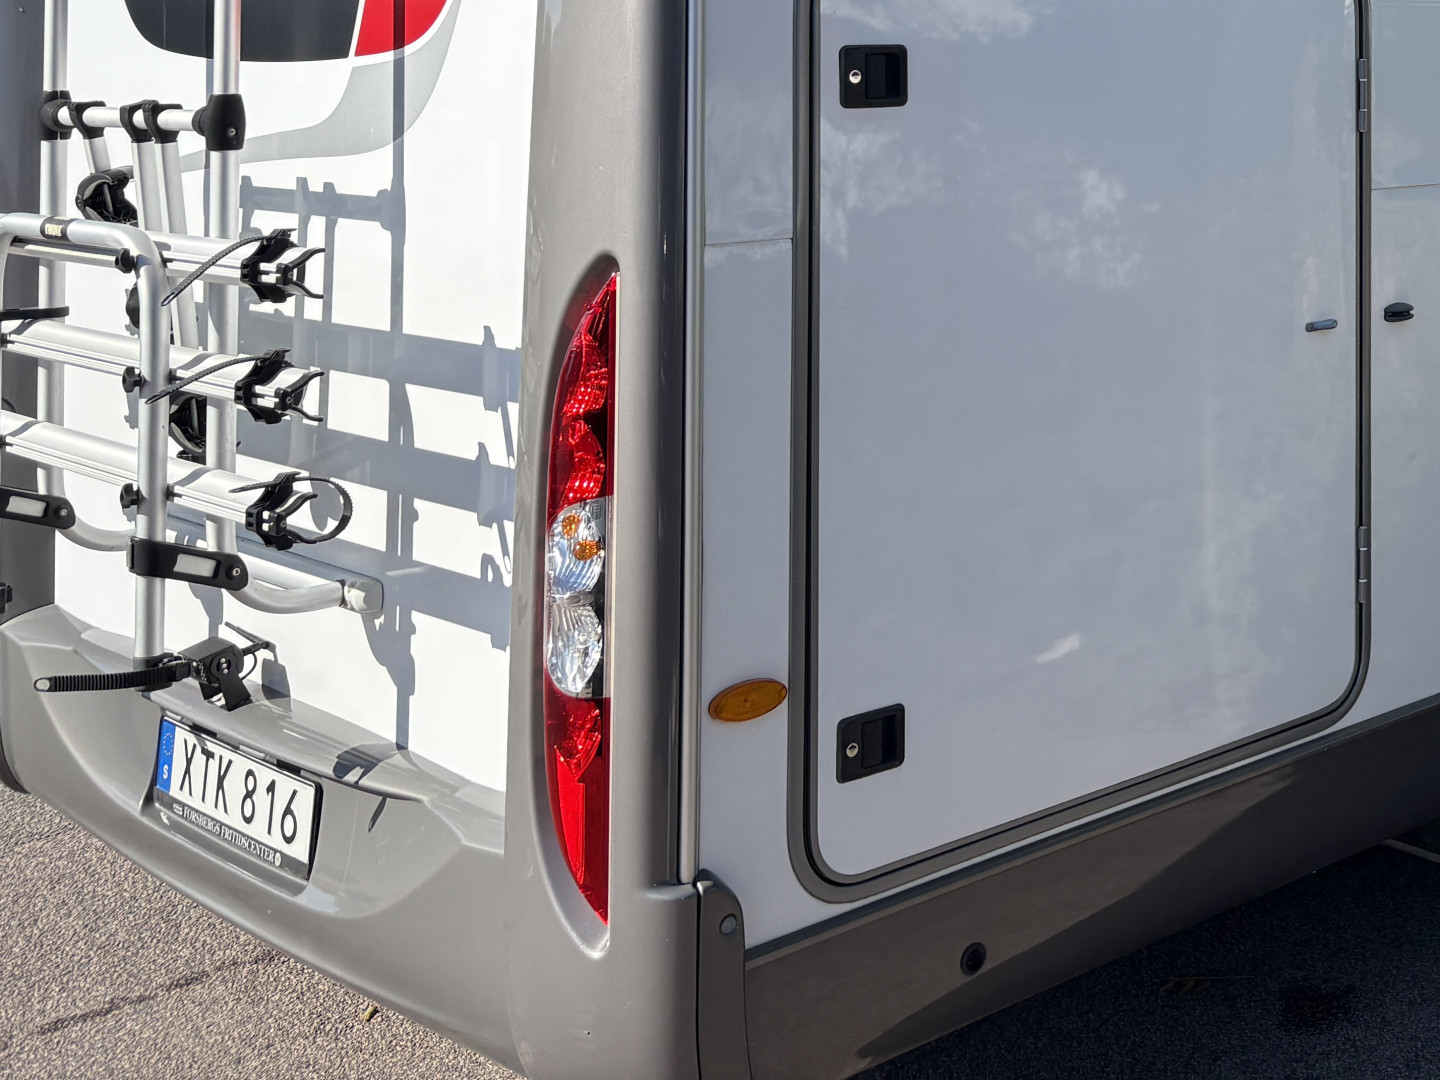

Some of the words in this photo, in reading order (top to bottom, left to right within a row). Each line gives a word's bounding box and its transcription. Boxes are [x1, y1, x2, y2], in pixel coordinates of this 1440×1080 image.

[162, 764, 169, 780] S
[179, 737, 234, 817] XTK
[240, 768, 298, 845] 816
[183, 806, 221, 835] FORSBERGS
[220, 825, 275, 864] FRITIDSCENTER
